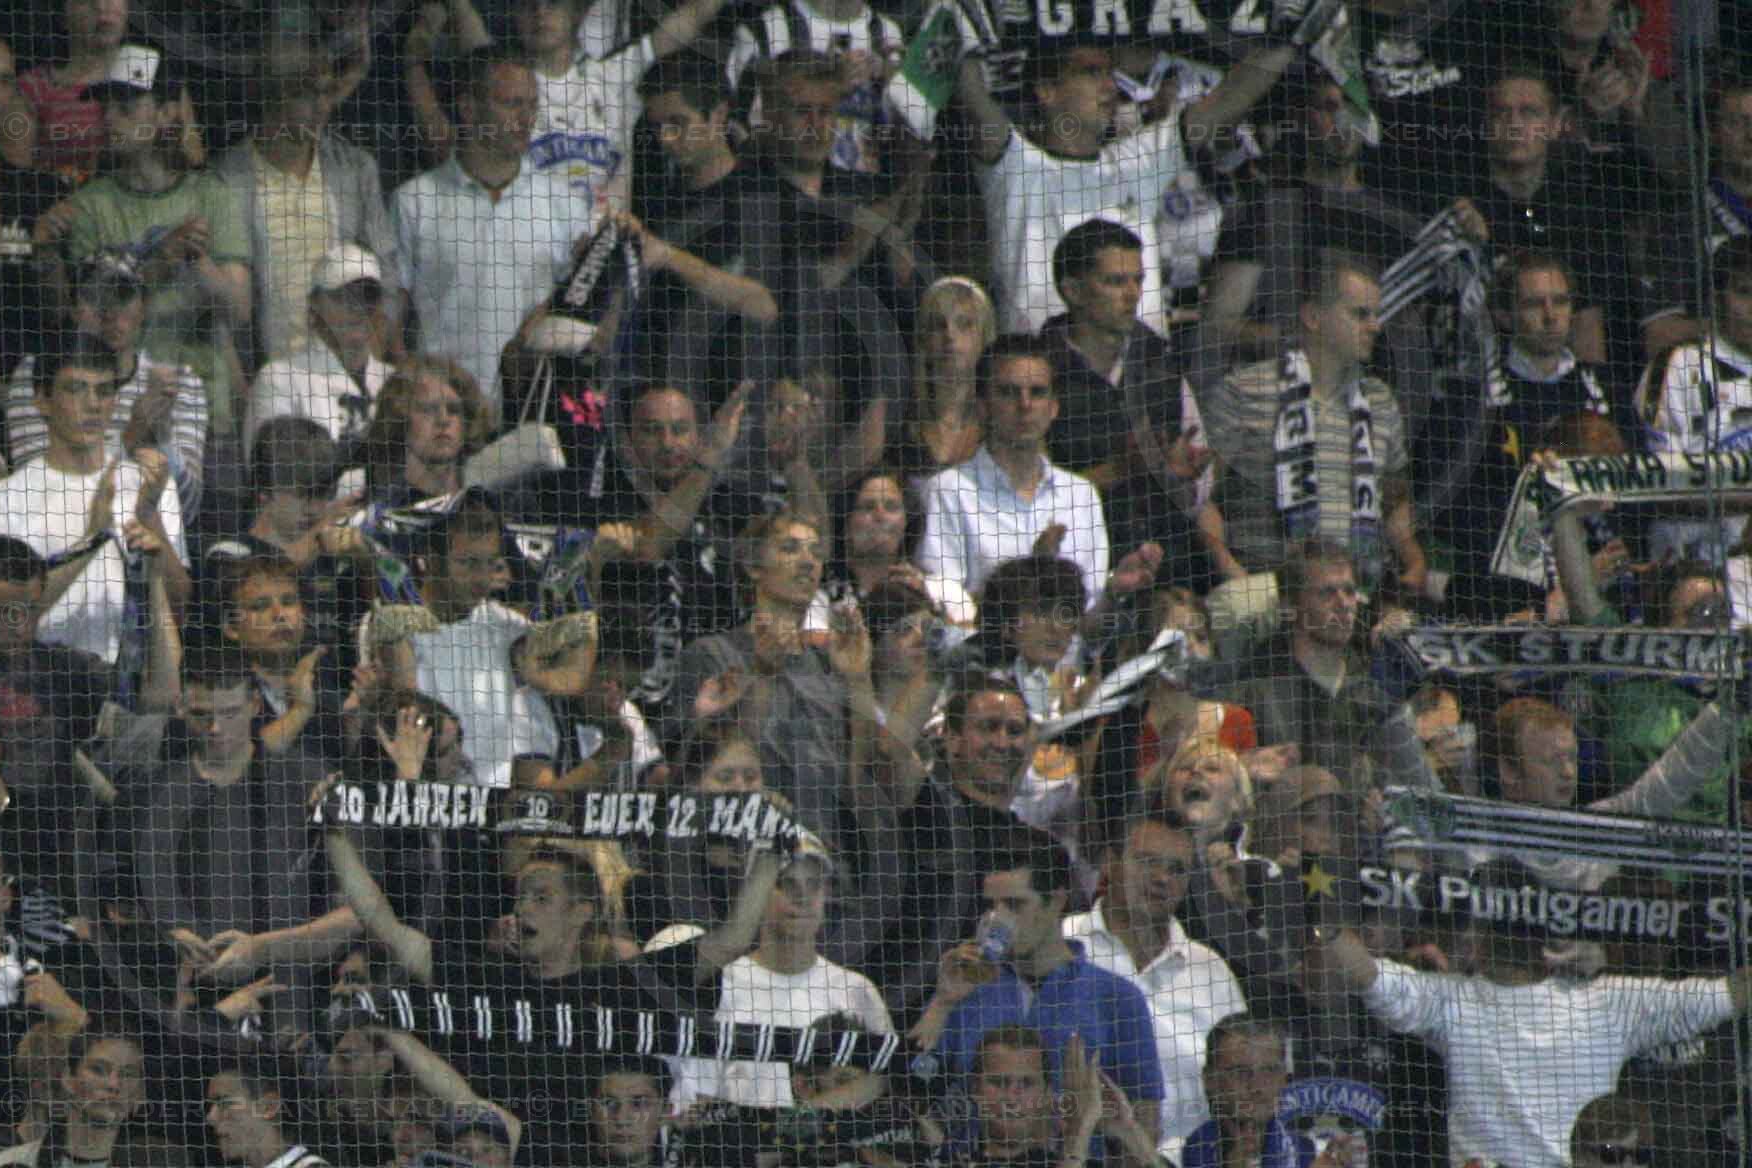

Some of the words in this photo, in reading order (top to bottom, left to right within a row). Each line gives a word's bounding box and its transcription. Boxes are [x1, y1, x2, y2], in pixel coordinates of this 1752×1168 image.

[334, 783, 363, 823] 10
[372, 780, 491, 827] JAHREN
[583, 792, 657, 836] EUER
[666, 794, 699, 838] 12.
[1358, 866, 1425, 910] SK
[1439, 875, 1690, 939] Puntigamer
